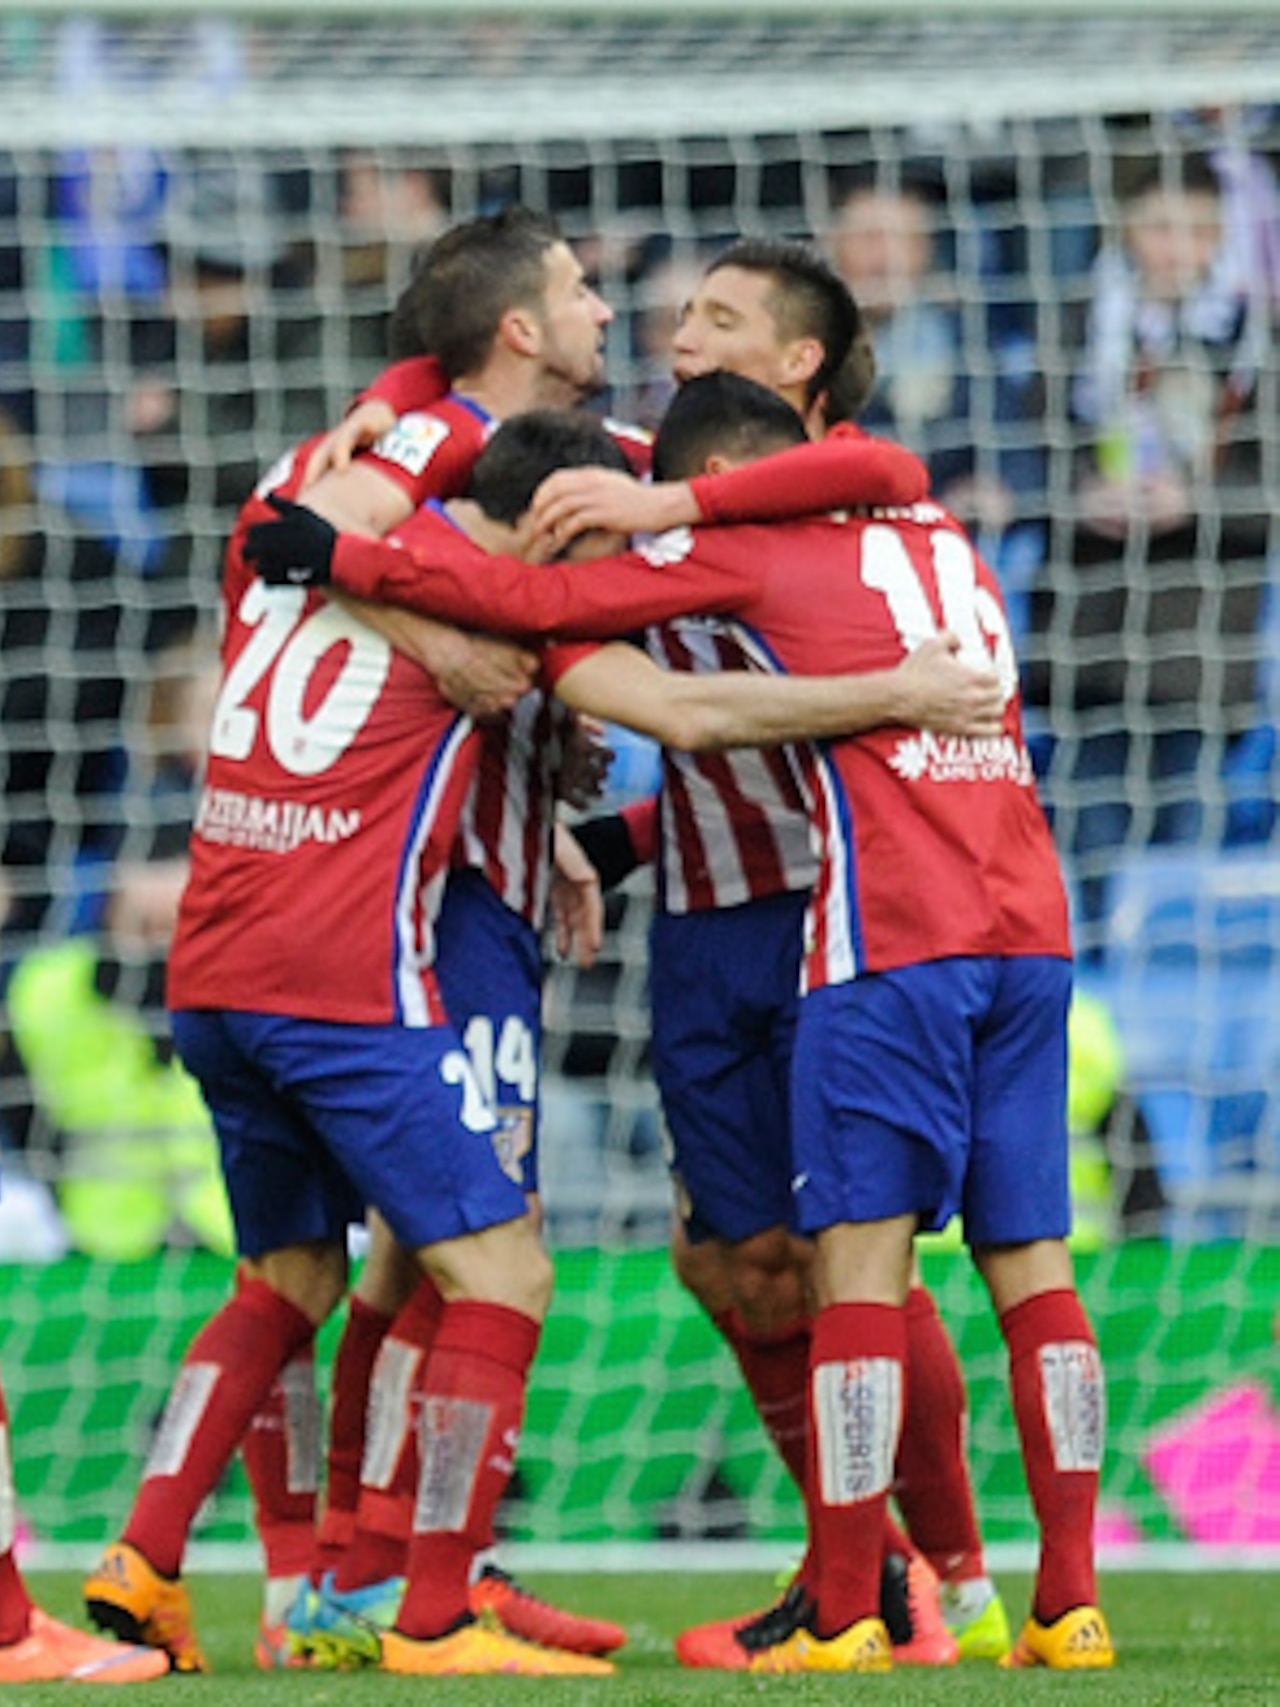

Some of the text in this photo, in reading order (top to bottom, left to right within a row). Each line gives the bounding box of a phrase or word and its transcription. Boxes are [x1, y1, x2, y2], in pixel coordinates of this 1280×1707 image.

[210, 576, 391, 777] 20
[860, 524, 1018, 702] 16
[463, 1015, 537, 1102] 14
